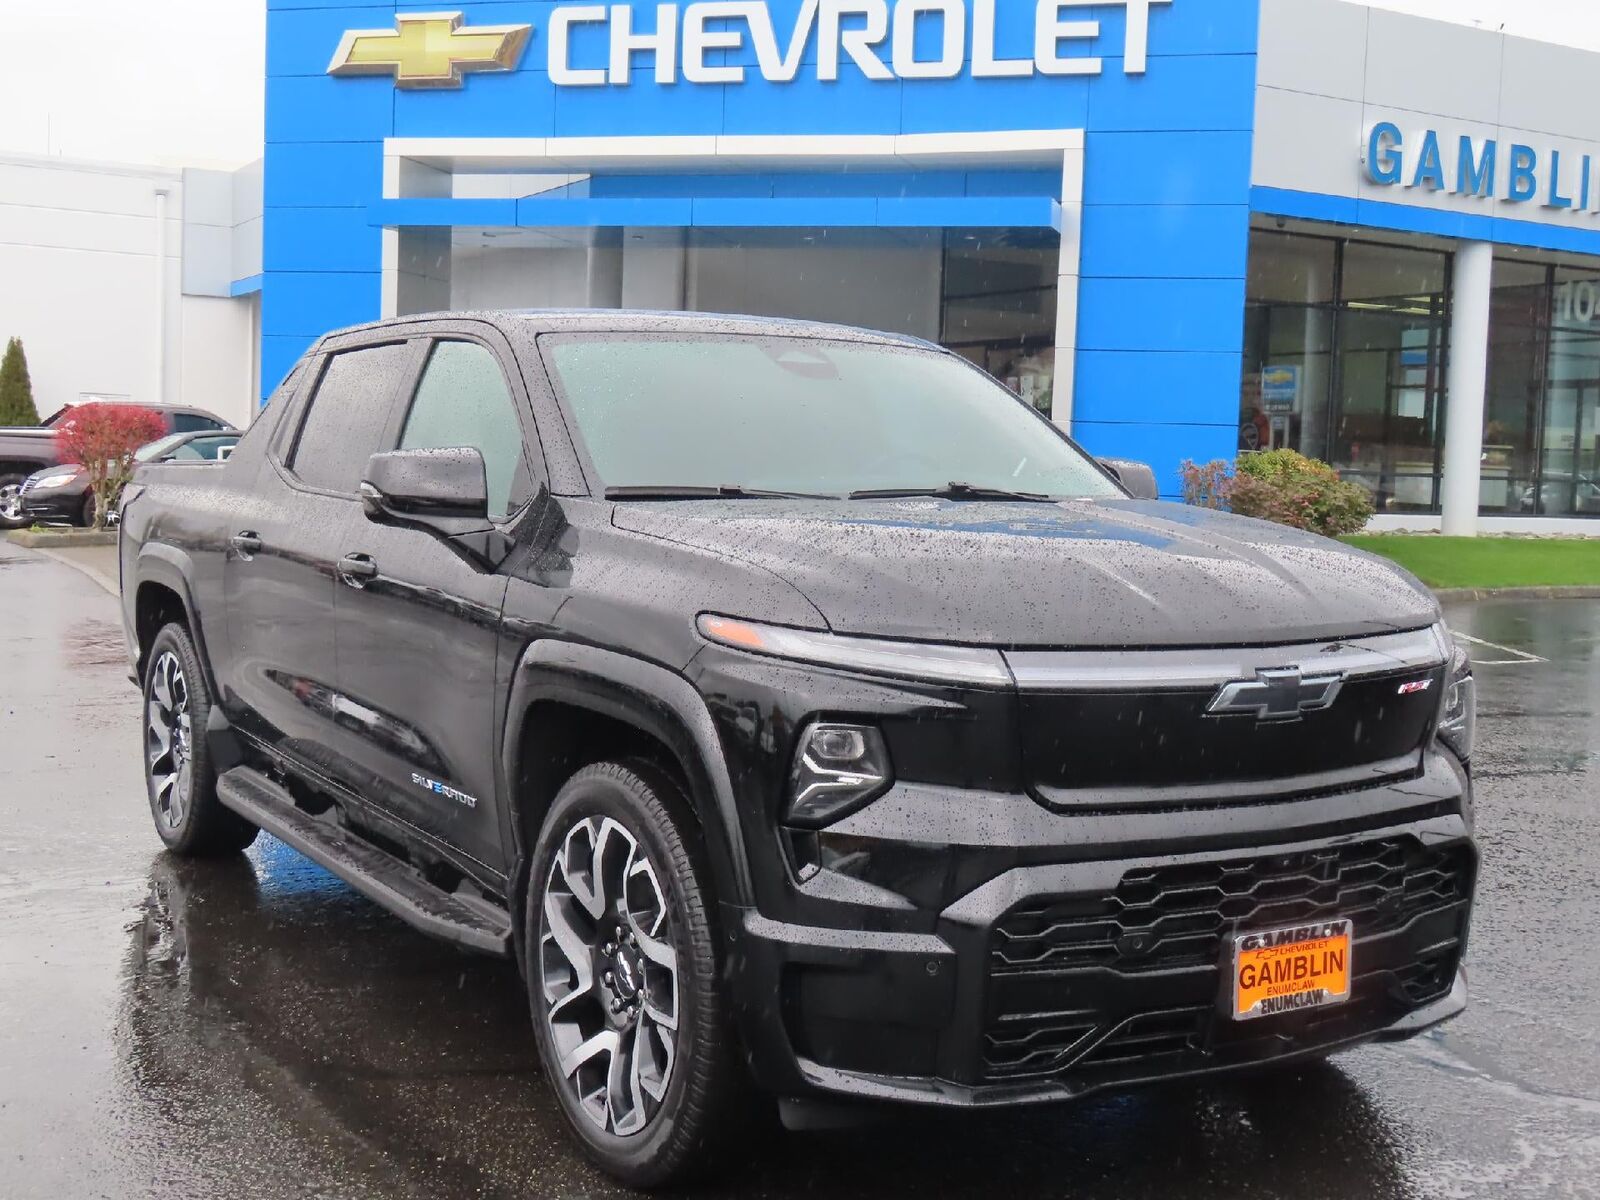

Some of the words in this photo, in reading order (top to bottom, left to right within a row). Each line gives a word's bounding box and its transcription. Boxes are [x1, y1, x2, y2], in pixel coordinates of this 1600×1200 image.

[547, 0, 1173, 86] CHEVROLET
[1367, 121, 1600, 212] GAMBLI
[1559, 279, 1600, 323] 10
[411, 772, 478, 808] SILVERADO
[1241, 921, 1347, 950] GAMBLIN
[1279, 940, 1330, 956] CHEVROLET
[1239, 949, 1344, 990] GAMBLIN
[1261, 988, 1324, 1014] ENUMCLAW
[1266, 980, 1315, 996] ENUMCLAW
